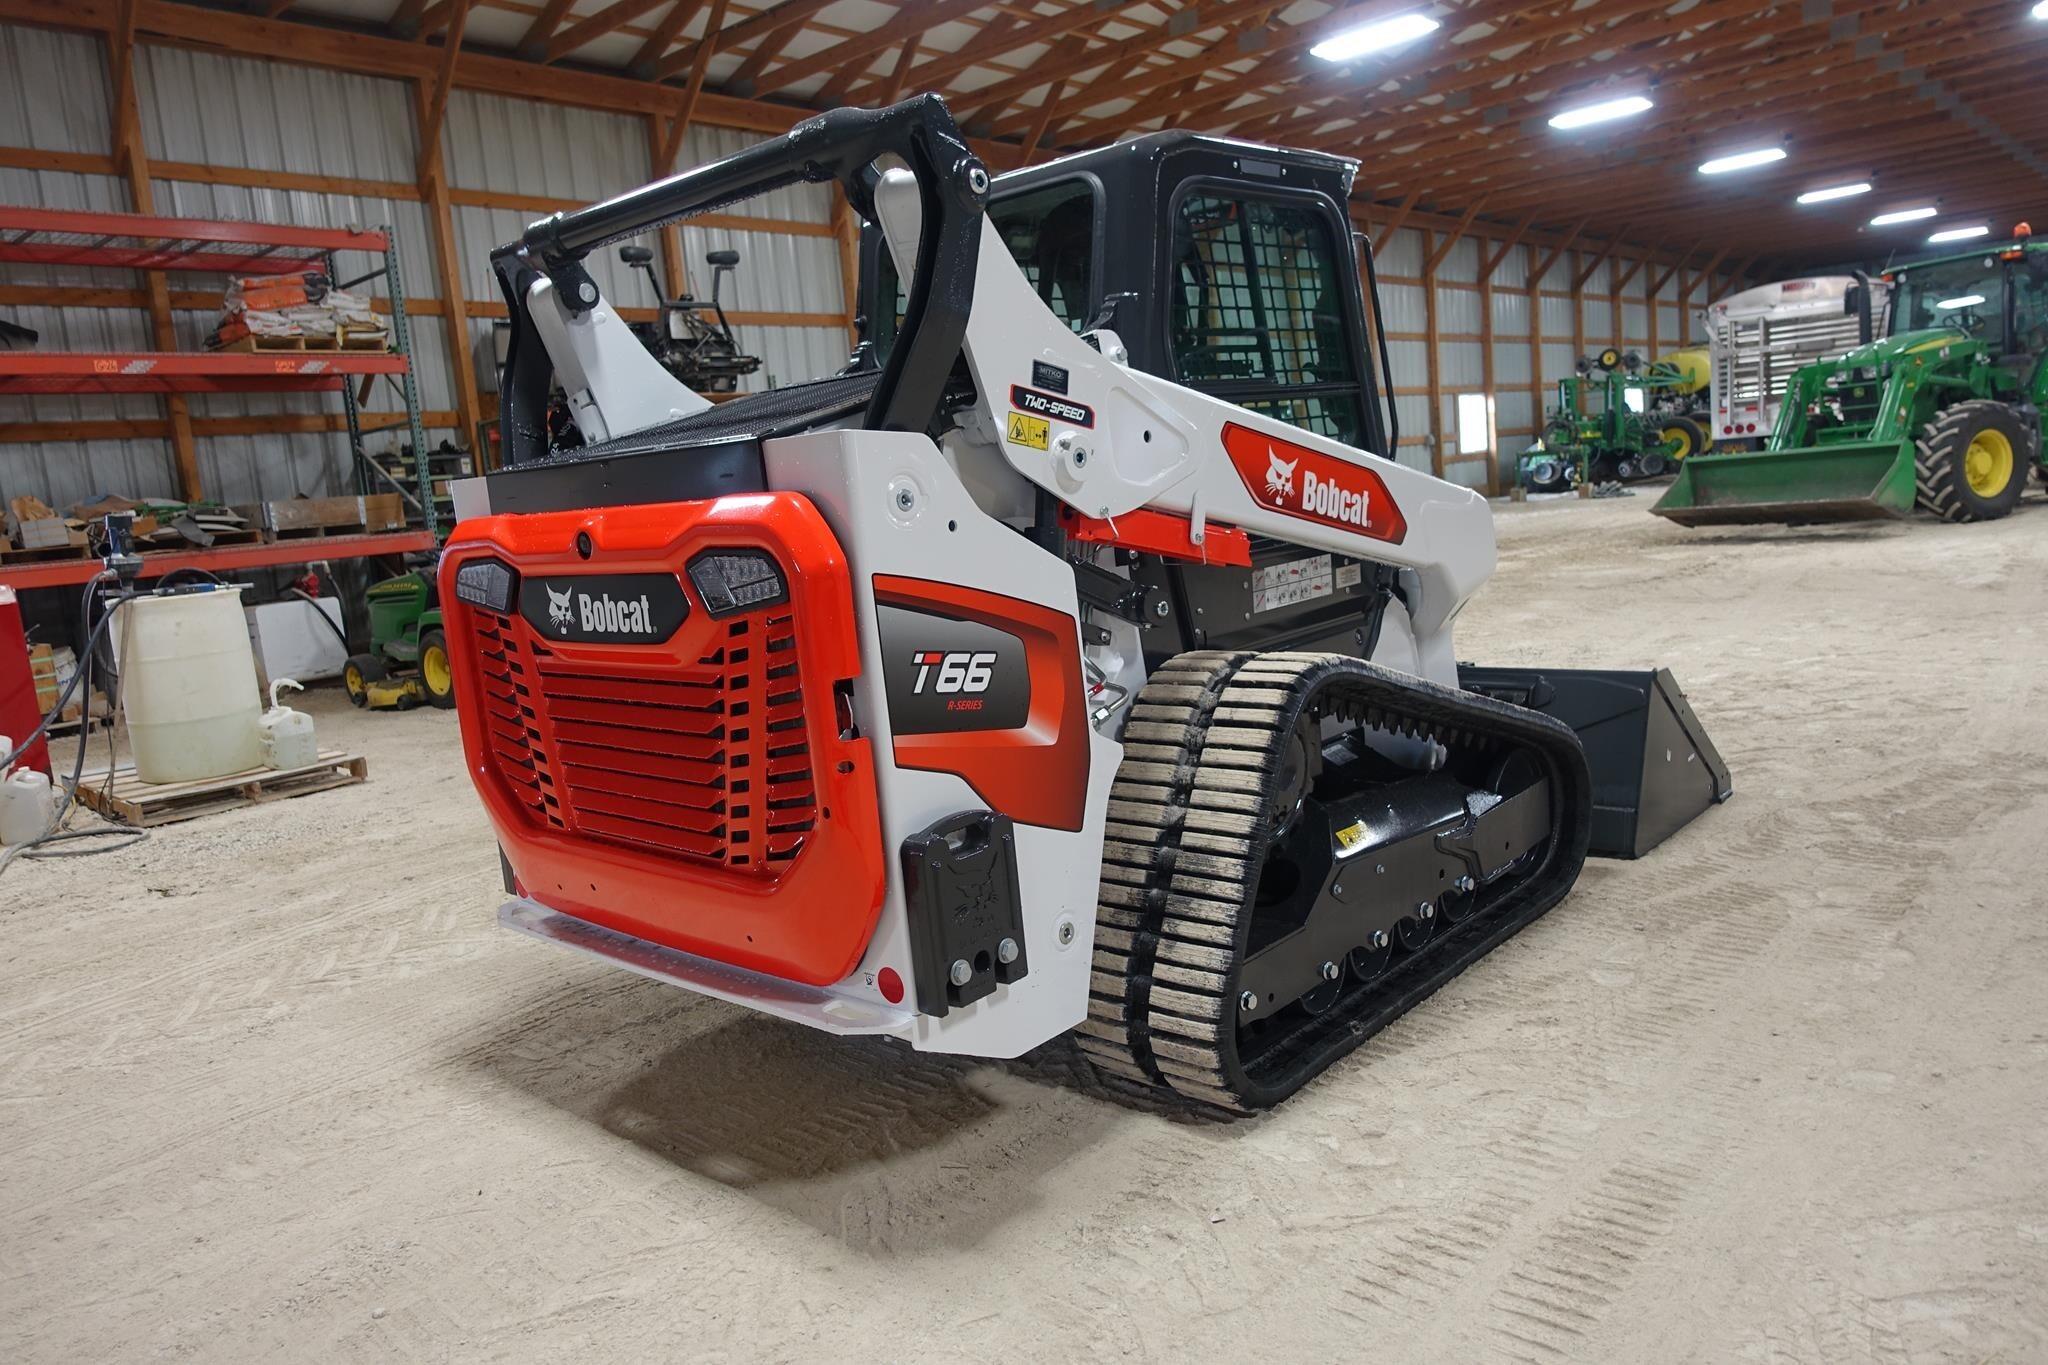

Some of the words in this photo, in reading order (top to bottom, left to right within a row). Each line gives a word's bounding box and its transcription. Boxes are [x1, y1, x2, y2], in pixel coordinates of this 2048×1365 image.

[1025, 394, 1086, 421] TWO-SPEED
[1302, 470, 1370, 527] Bobcat
[578, 593, 652, 633] Bobcat
[913, 652, 997, 694] T66
[947, 700, 984, 711] R-SERIES
